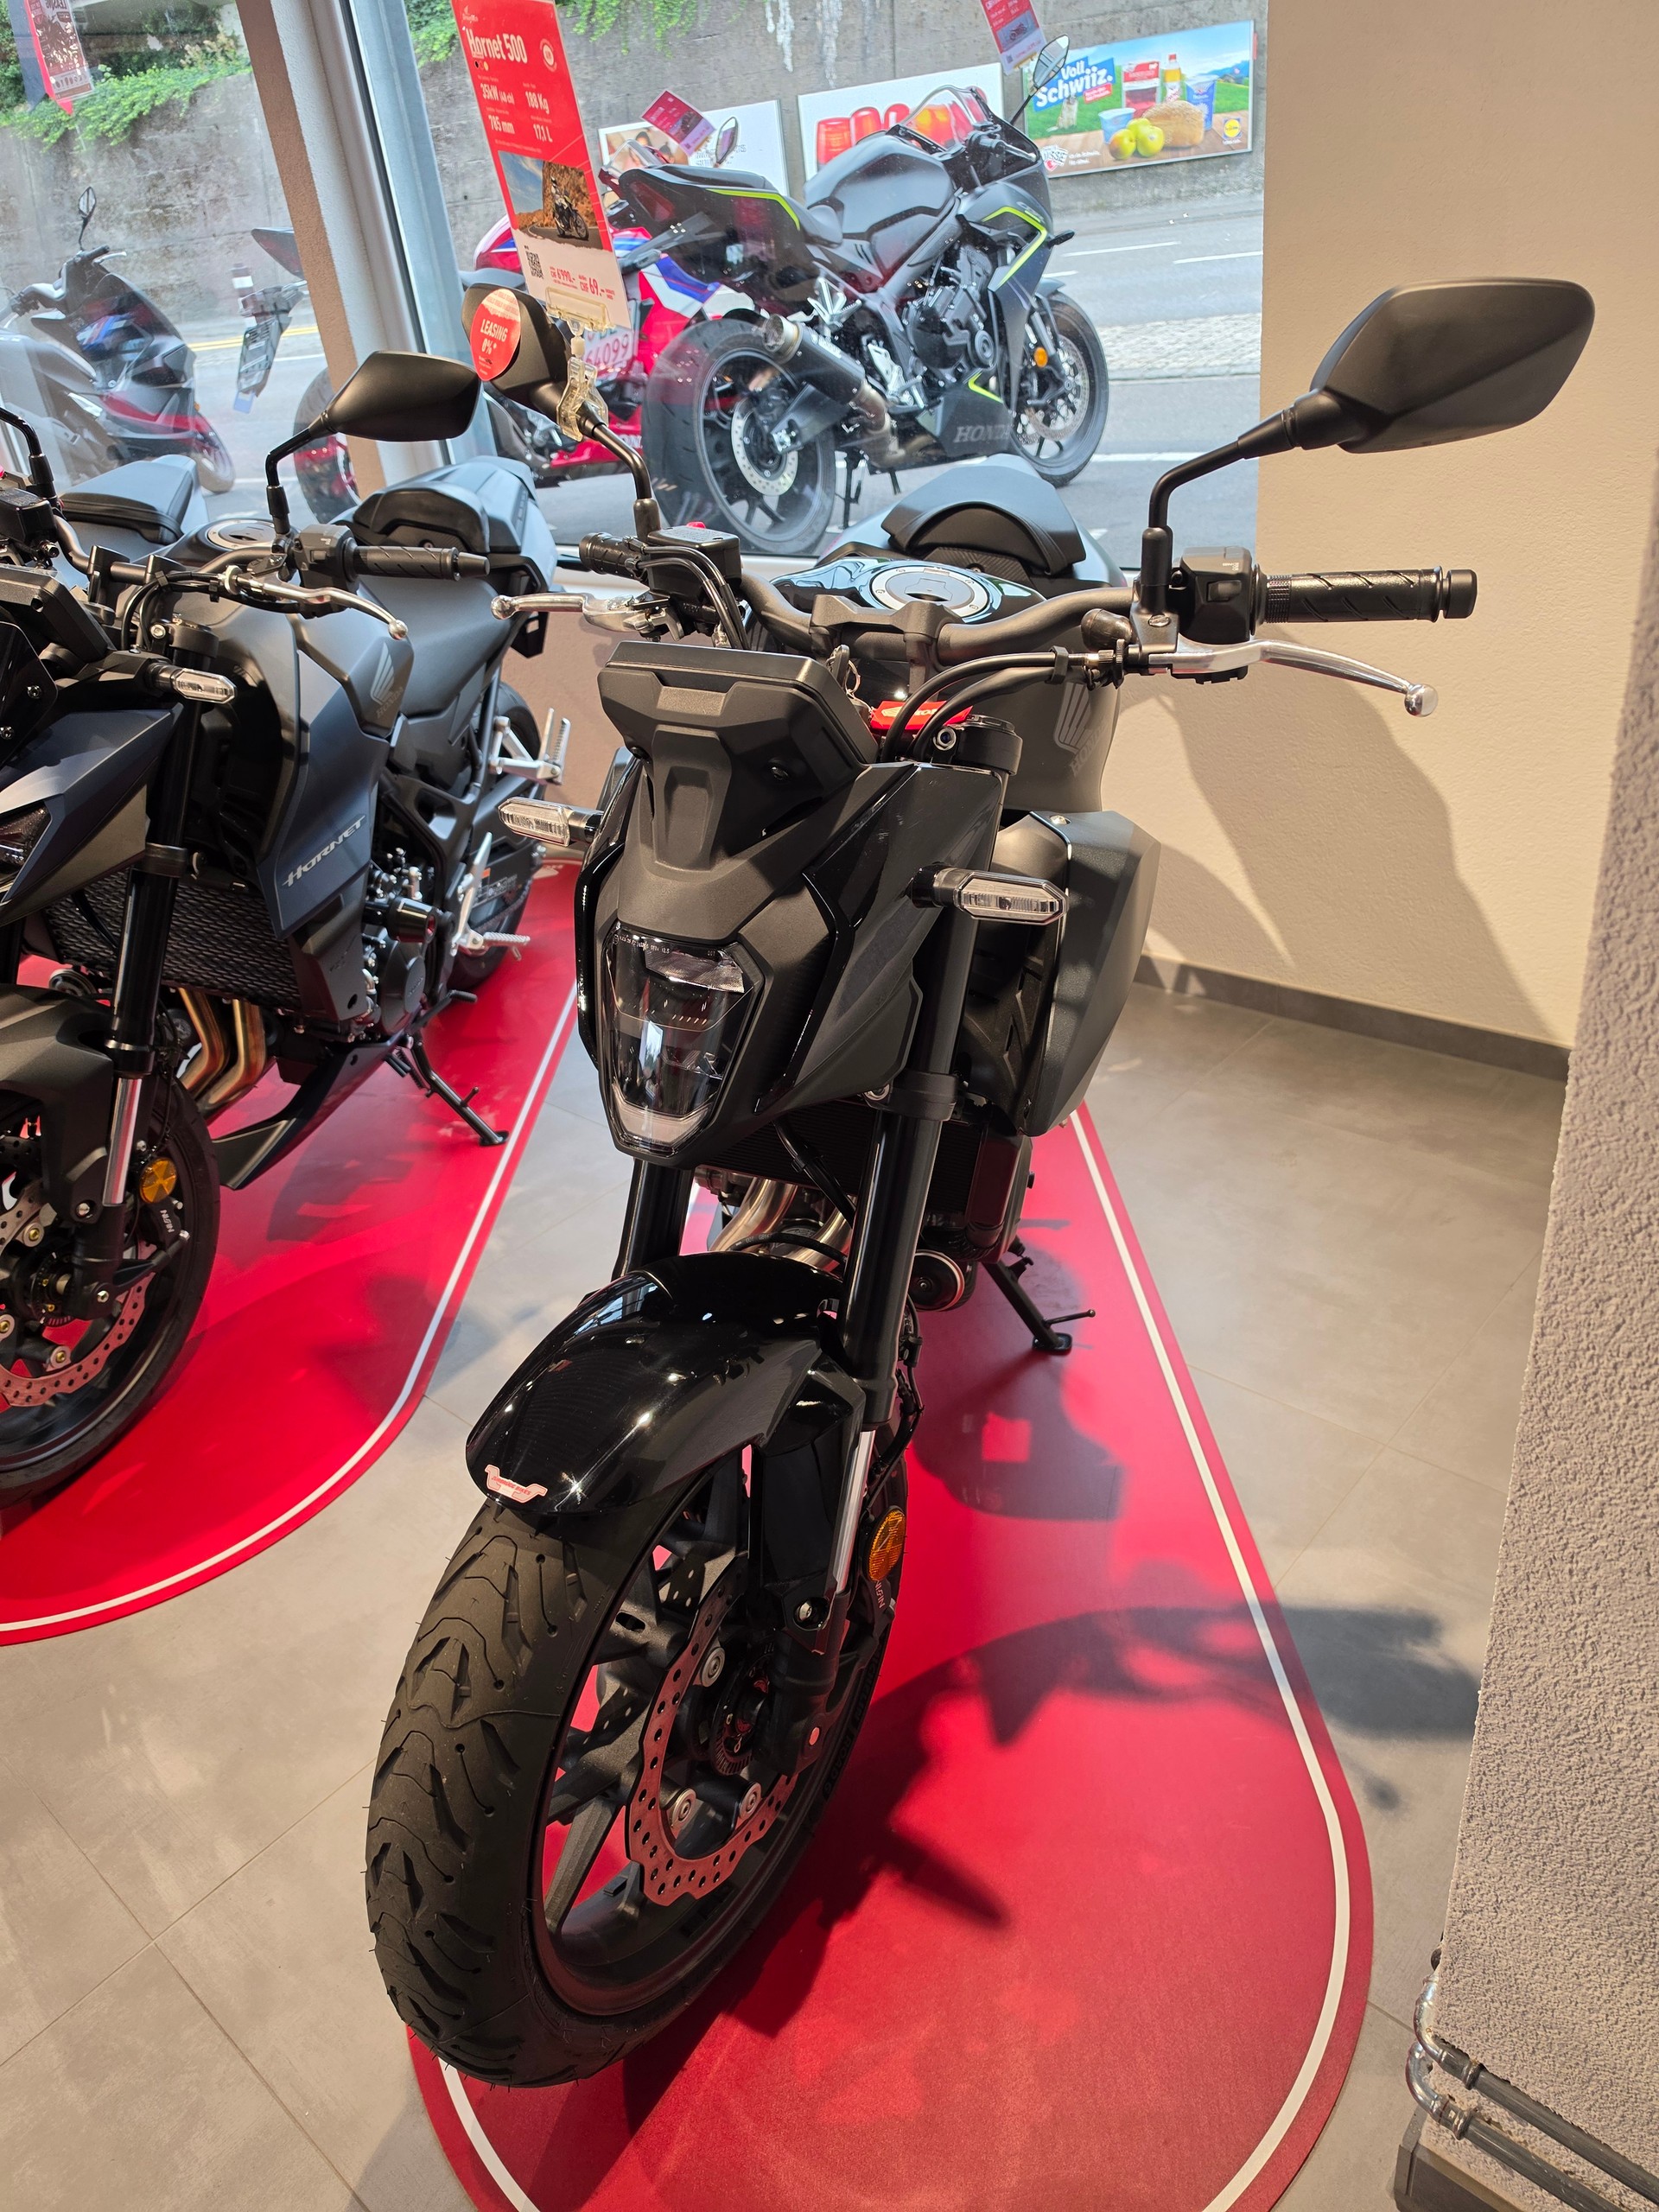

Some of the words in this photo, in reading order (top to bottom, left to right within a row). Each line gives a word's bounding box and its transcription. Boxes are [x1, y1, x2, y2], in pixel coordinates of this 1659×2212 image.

[466, 29, 506, 60] Hornet
[503, 33, 528, 64] 500
[1060, 60, 1085, 80] Voll
[480, 83, 499, 101] 35kW
[537, 92, 550, 115] Kg
[488, 114, 502, 131] 785
[501, 121, 515, 135] mm
[545, 126, 553, 143] L
[480, 318, 509, 342] LEASING
[282, 815, 365, 887] HORNET
